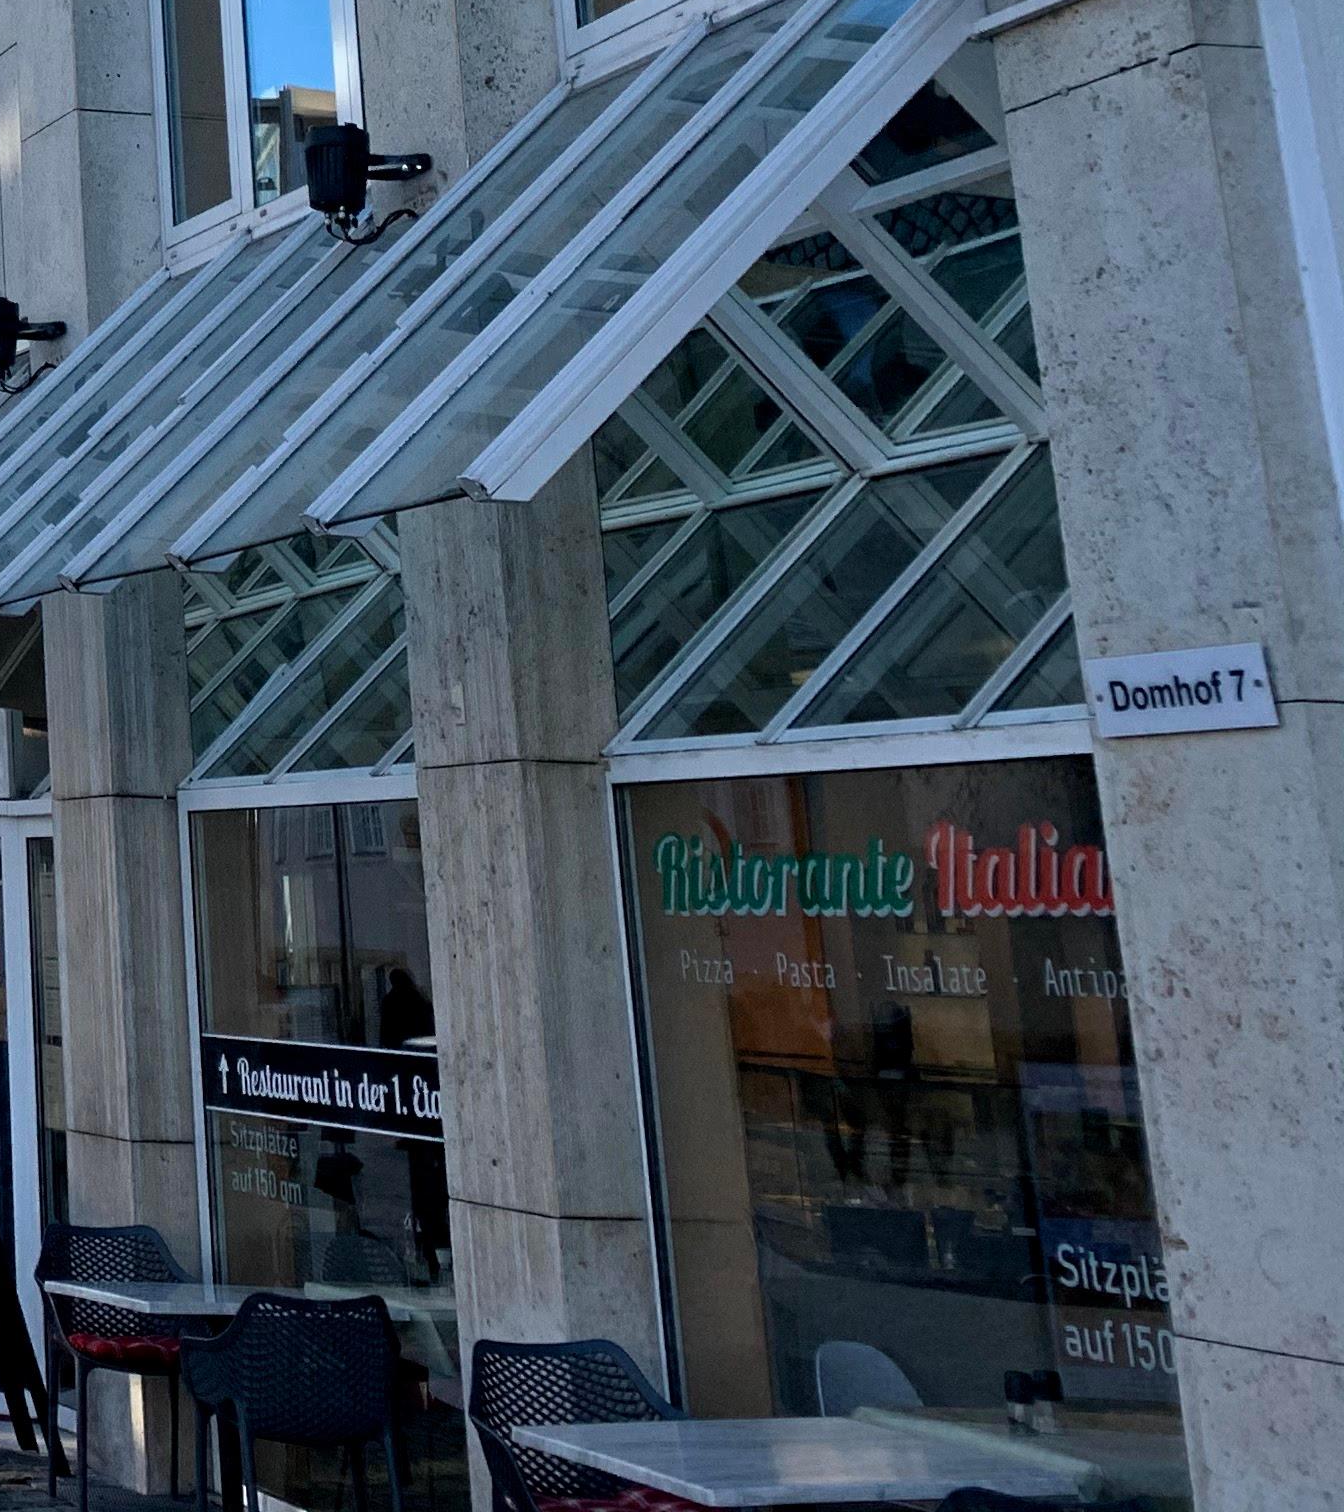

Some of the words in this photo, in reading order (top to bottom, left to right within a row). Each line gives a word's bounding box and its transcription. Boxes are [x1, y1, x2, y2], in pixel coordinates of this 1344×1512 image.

[1108, 670, 1223, 712] Domhof
[1228, 669, 1245, 702] 7
[653, 831, 914, 918] Ristorante
[923, 820, 1116, 918] Italia
[681, 949, 735, 985] Pizza
[776, 952, 837, 989] Pasta
[882, 954, 988, 996] Insalate
[236, 1056, 332, 1106] Restaurant
[334, 1068, 354, 1109] in
[358, 1072, 389, 1113] der
[392, 1074, 409, 1116] 1.
[230, 1120, 299, 1160] Sitzplätze
[232, 1167, 253, 1193] auf
[254, 1168, 277, 1199] 150
[279, 1179, 304, 1209] qm
[1064, 1319, 1115, 1364] auf
[1121, 1322, 1178, 1374] 150
